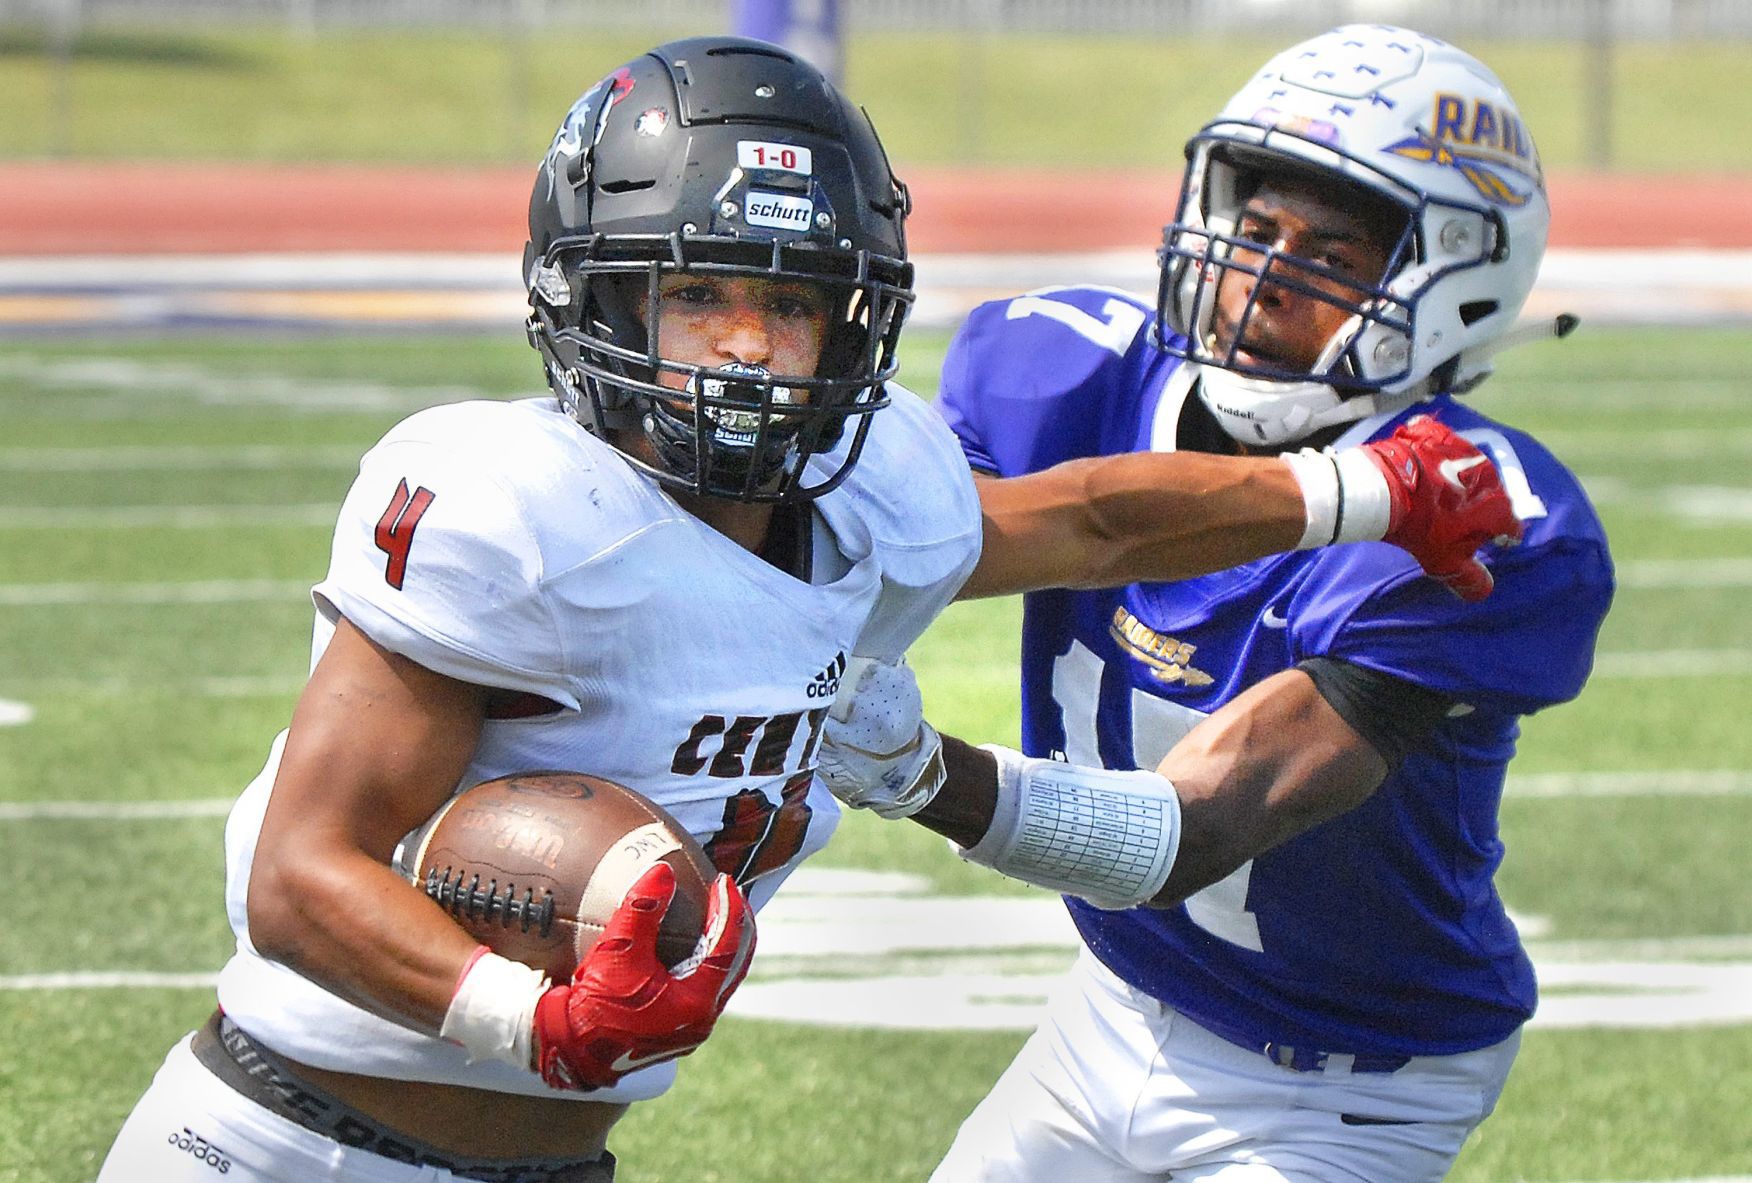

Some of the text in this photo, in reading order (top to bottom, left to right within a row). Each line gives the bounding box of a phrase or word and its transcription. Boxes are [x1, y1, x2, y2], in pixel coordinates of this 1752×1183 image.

[753, 147, 797, 169] 1-0
[749, 202, 810, 222] schutt
[374, 476, 436, 592] 4
[168, 1132, 231, 1174] adidas
